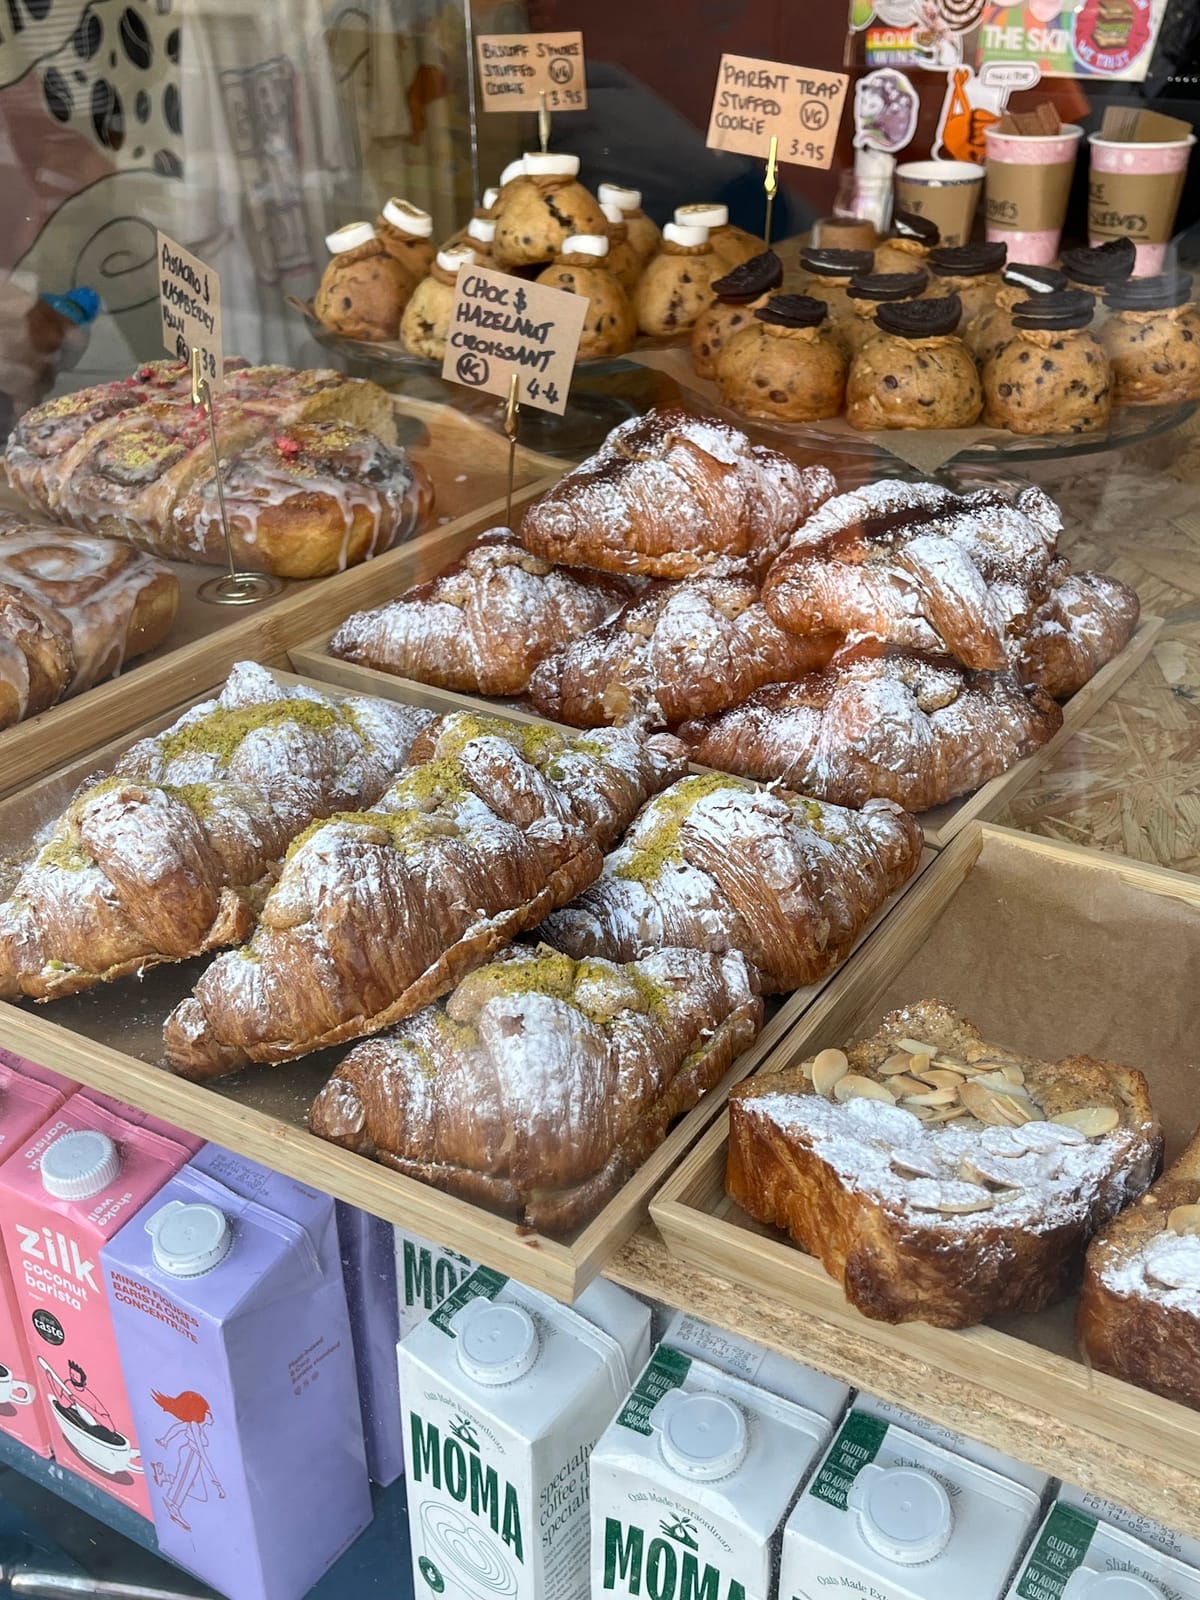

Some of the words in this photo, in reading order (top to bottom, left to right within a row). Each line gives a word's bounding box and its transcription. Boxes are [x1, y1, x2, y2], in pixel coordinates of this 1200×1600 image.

[984, 25, 1023, 50] THE
[484, 64, 537, 77] STUFFED
[550, 90, 583, 106] 3.95
[719, 91, 782, 117] STUFFED
[789, 138, 825, 162] 3.95
[462, 275, 509, 306] CHOC
[456, 302, 556, 345] HAZELNUT
[450, 331, 556, 373] CROISSANT
[22, 1259, 89, 1301] coconut
[24, 1271, 82, 1312] barista
[110, 1270, 150, 1296] MINOR
[151, 1289, 199, 1328] FIGURES
[112, 1281, 163, 1311] BARISTA
[164, 1305, 190, 1330] CHAI
[33, 1317, 64, 1340] taste
[114, 1291, 199, 1345] CONCENTRATE
[646, 1384, 665, 1399] FREE
[626, 1400, 639, 1411] NO
[636, 1405, 653, 1418] ADD
[838, 1453, 860, 1471] FREE
[840, 1439, 870, 1461] GLUTEN
[410, 1410, 525, 1566] MOMA
[819, 1470, 833, 1482] NO
[540, 1477, 577, 1528] coffee
[818, 1483, 846, 1504] SUGAR
[541, 1485, 591, 1549] specialt
[648, 1492, 674, 1507] Made
[674, 1502, 734, 1554] Extraordinary
[1046, 1535, 1079, 1559] GLUTEN
[1046, 1550, 1066, 1570] FREE
[1105, 1559, 1141, 1580] Shake
[1142, 1571, 1161, 1586] me
[839, 1576, 867, 1593] Made
[1025, 1567, 1039, 1581] NO
